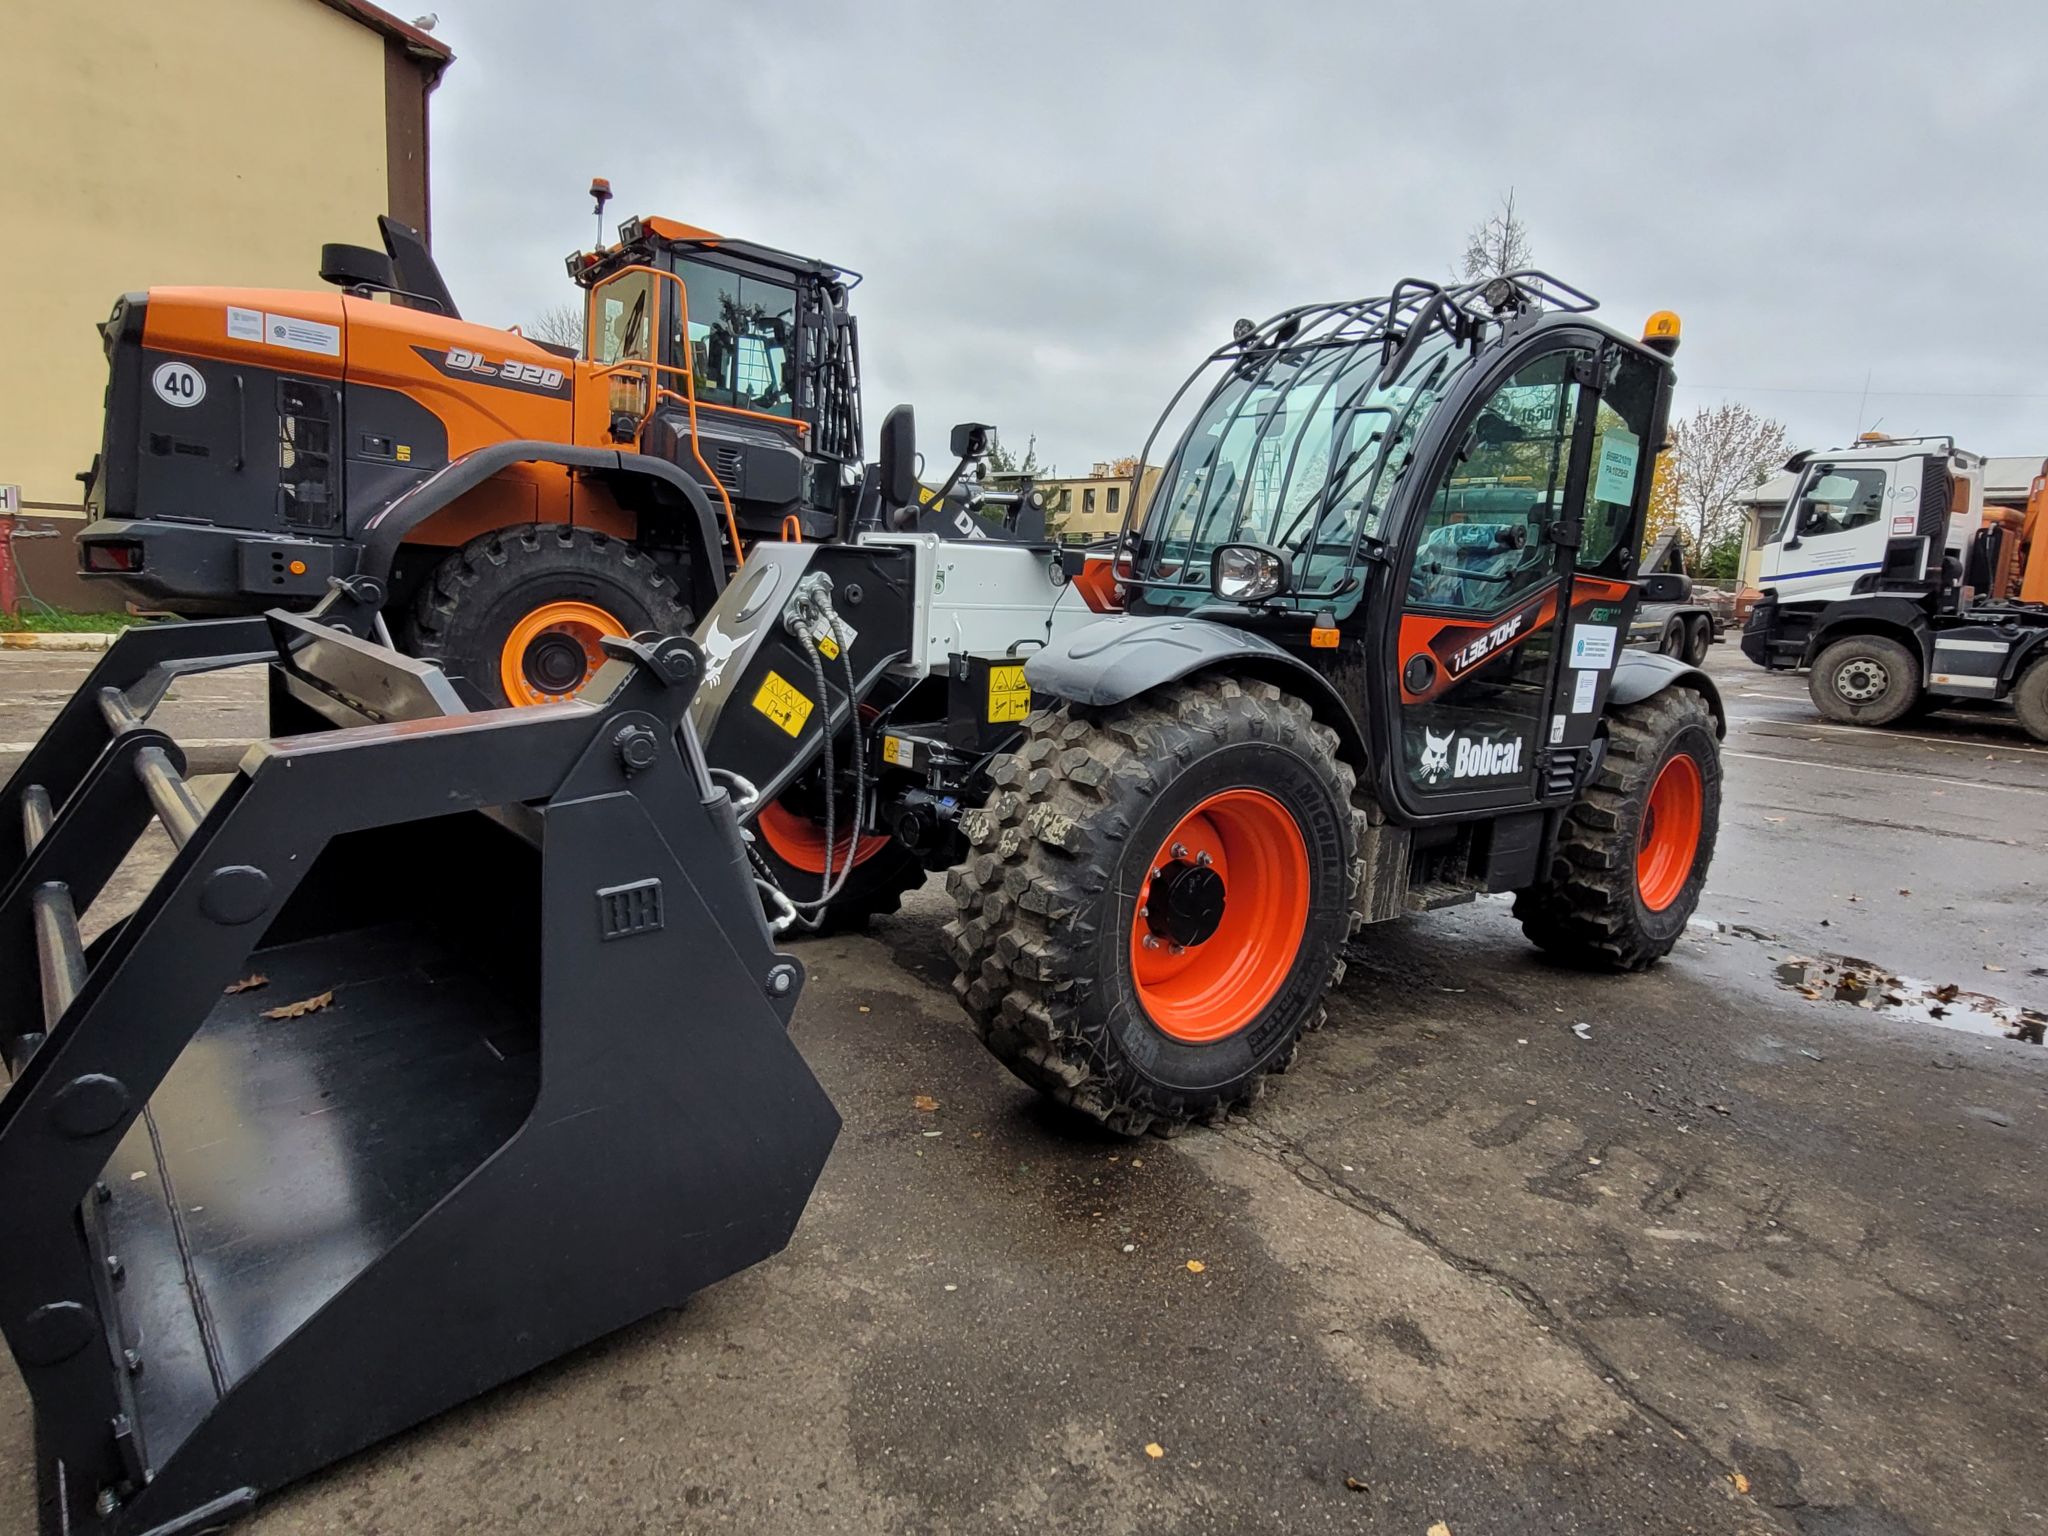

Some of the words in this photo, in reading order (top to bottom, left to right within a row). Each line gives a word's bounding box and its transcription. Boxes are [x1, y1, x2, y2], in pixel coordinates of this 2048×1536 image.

[164, 372, 195, 398] 40
[445, 346, 498, 377] DL
[500, 358, 565, 390] 320
[1453, 736, 1522, 778] Bobcat
